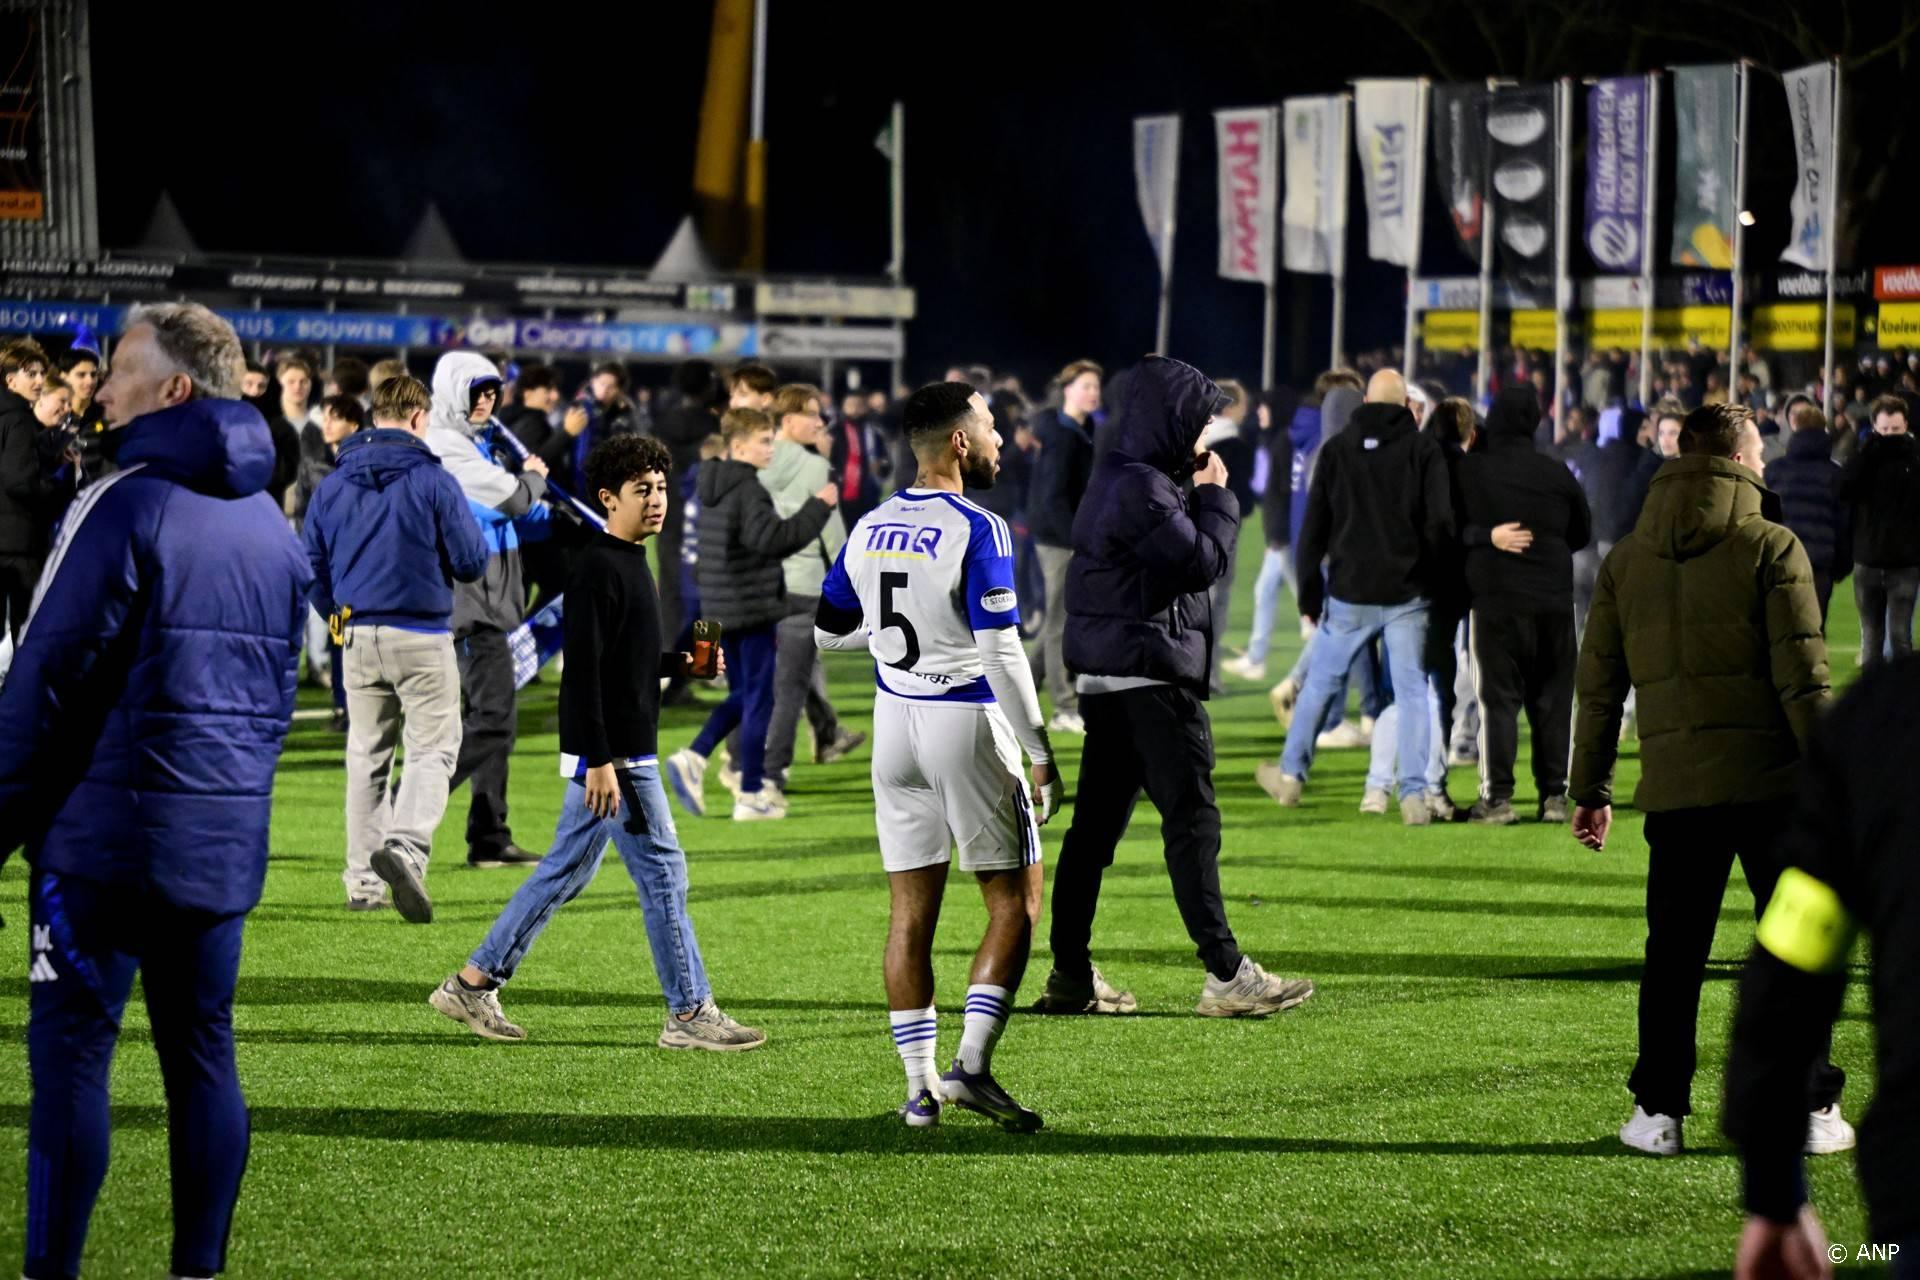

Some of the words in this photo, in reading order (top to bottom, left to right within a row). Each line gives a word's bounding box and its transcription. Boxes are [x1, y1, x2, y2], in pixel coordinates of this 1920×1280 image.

[2, 262, 70, 274] HEINEN
[94, 263, 175, 277] HOPMAN
[231, 274, 317, 289] COMFORT
[297, 319, 394, 340] BOUWEN
[865, 522, 943, 561] TinQ
[879, 571, 921, 673] 5
